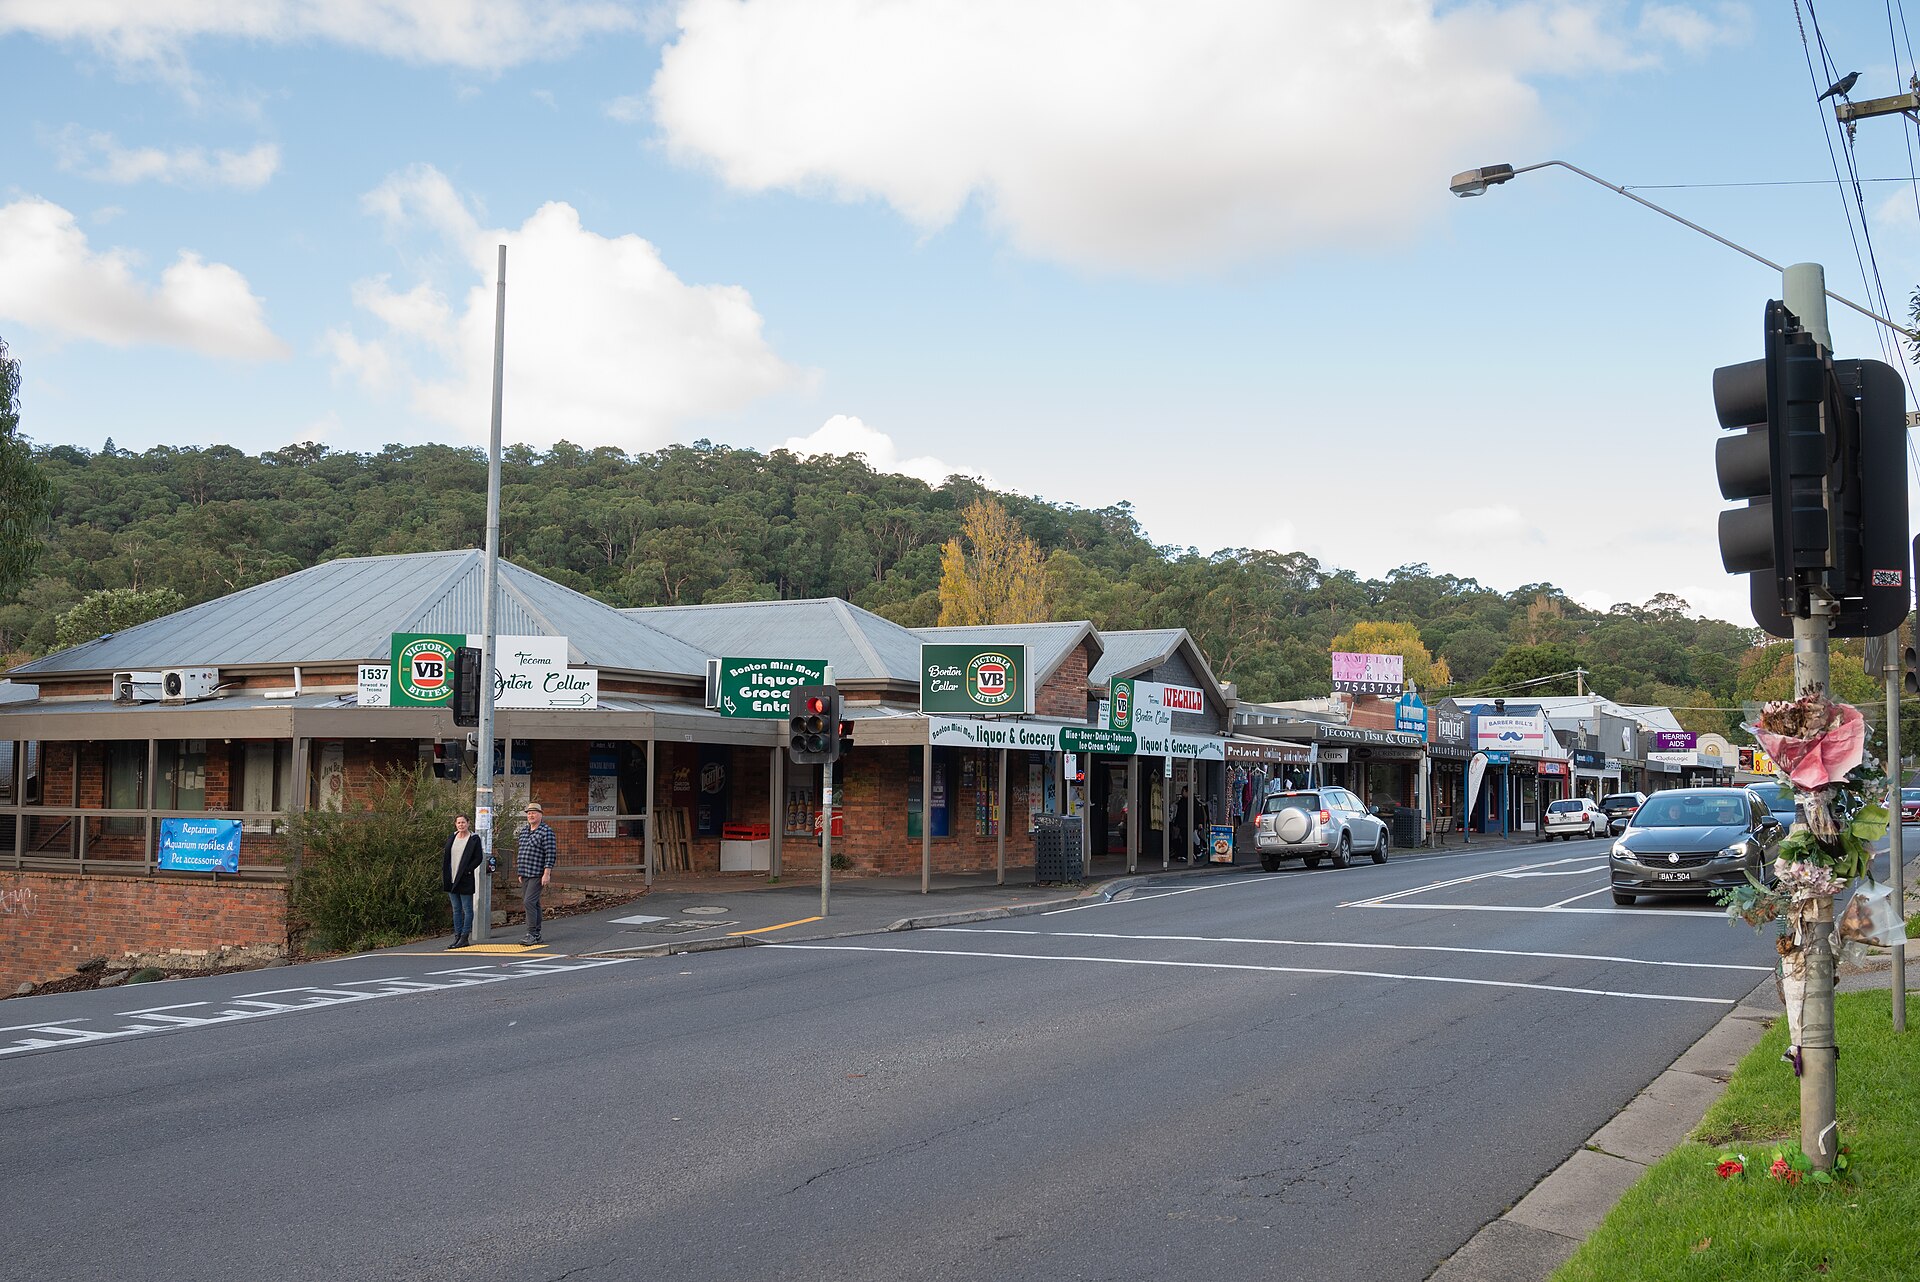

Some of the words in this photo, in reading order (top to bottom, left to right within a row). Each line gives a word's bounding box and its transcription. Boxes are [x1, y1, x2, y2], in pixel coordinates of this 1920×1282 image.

[405, 643, 452, 659] VICTORIA
[514, 651, 552, 665] Tecoma
[971, 656, 1011, 670] VICTORIA
[1333, 654, 1401, 664] CAMELOT
[360, 669, 388, 680] 1537
[414, 662, 444, 678] VB
[730, 663, 767, 677] Bonton
[770, 661, 793, 670] Mini
[795, 664, 820, 679] Mart
[928, 665, 962, 677] Bonton
[1336, 672, 1399, 681] FLORIST
[494, 673, 533, 690] onton
[543, 672, 590, 693] Cellar
[751, 673, 805, 687] liquor
[931, 679, 958, 692] Cellar
[979, 673, 1004, 686] VB
[408, 685, 449, 698] BITTER
[739, 686, 790, 698] Groce
[1335, 681, 1401, 694] 97543784
[974, 693, 1009, 703] BITTER
[1117, 699, 1127, 711] VB
[932, 724, 950, 739] Bonton
[951, 723, 963, 732] Mini
[963, 727, 975, 742] Mart
[976, 725, 1006, 746] liquor
[1009, 727, 1016, 744] &
[1019, 728, 1055, 750] Grocery
[1065, 730, 1078, 739] Wine
[1080, 731, 1093, 740] Beer
[1095, 732, 1110, 742] Drinks
[1112, 733, 1132, 742] Tobacco
[1320, 725, 1360, 738] TECOMA
[1364, 730, 1383, 742] FISH
[1386, 733, 1396, 744] &
[1397, 734, 1419, 745] CHIPS
[1079, 741, 1087, 749] Ice
[1087, 741, 1104, 751] Cream
[1107, 742, 1120, 751] Chips
[1141, 736, 1163, 753] liquor
[1164, 738, 1169, 752] &
[1171, 738, 1197, 758] Grocery
[1324, 750, 1343, 760] CHIPS
[182, 823, 217, 835] Reptarium
[164, 838, 196, 850] Aquarium
[198, 840, 225, 852] reptiles
[226, 841, 234, 851] &
[171, 852, 182, 863] Pet
[184, 855, 222, 865] accessories
